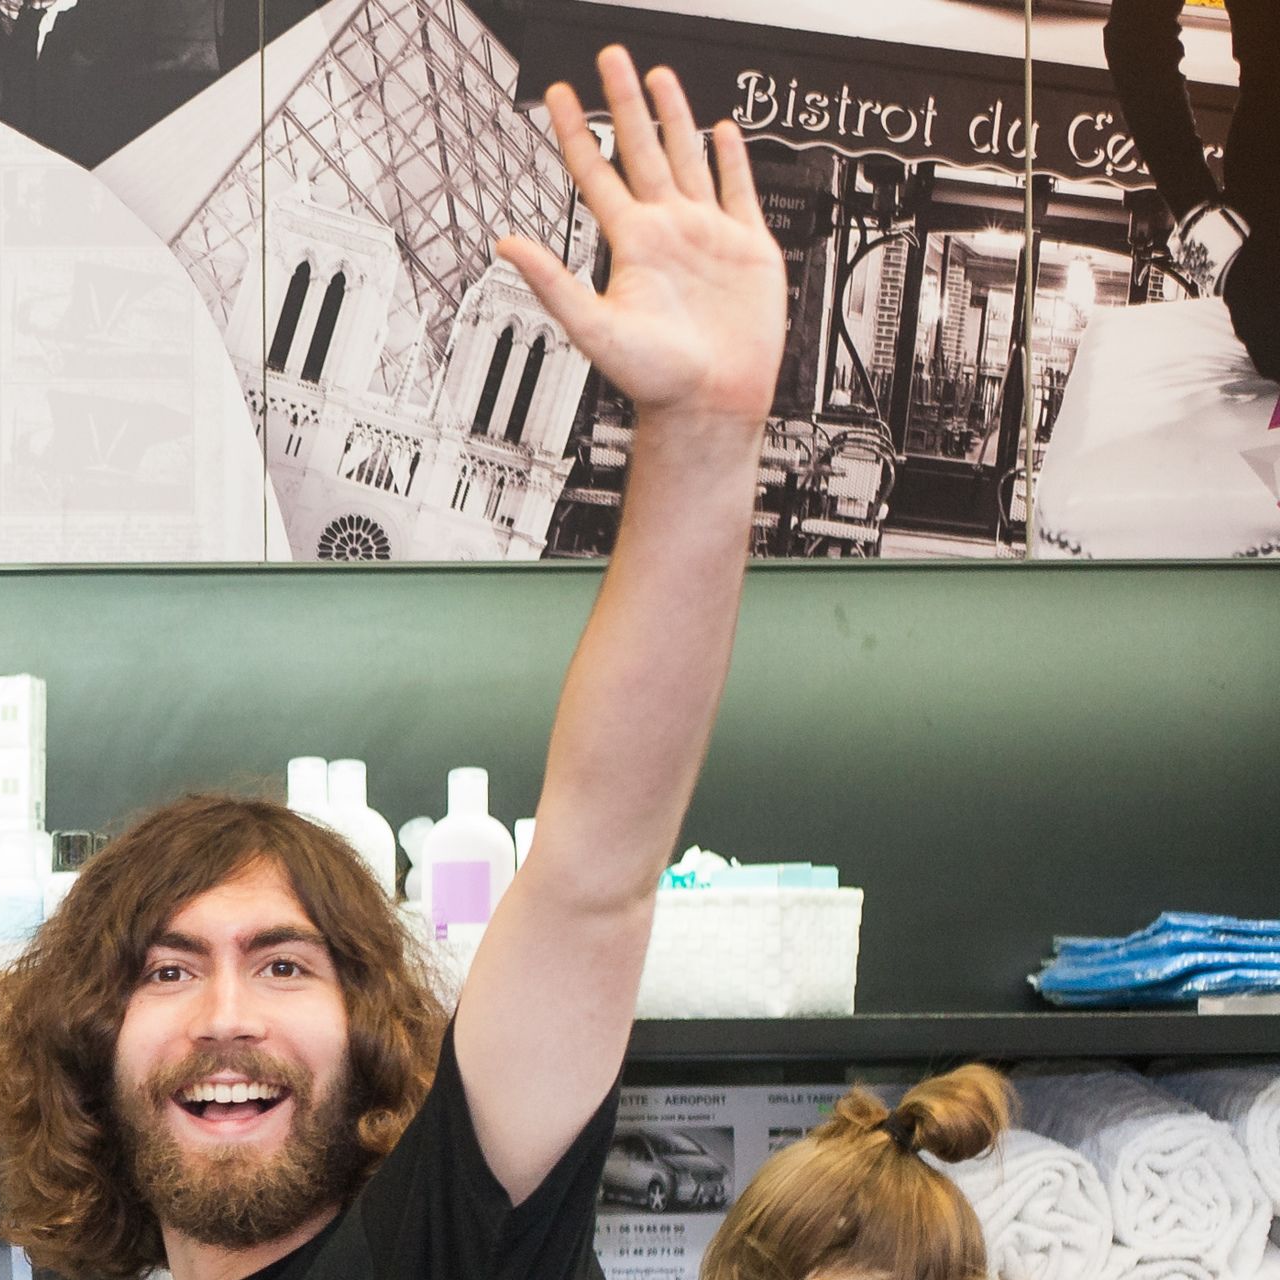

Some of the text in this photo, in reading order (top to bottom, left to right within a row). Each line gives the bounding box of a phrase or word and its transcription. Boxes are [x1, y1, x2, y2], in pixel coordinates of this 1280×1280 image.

[732, 69, 1040, 160] Bistrot du
[769, 194, 805, 210] Hours
